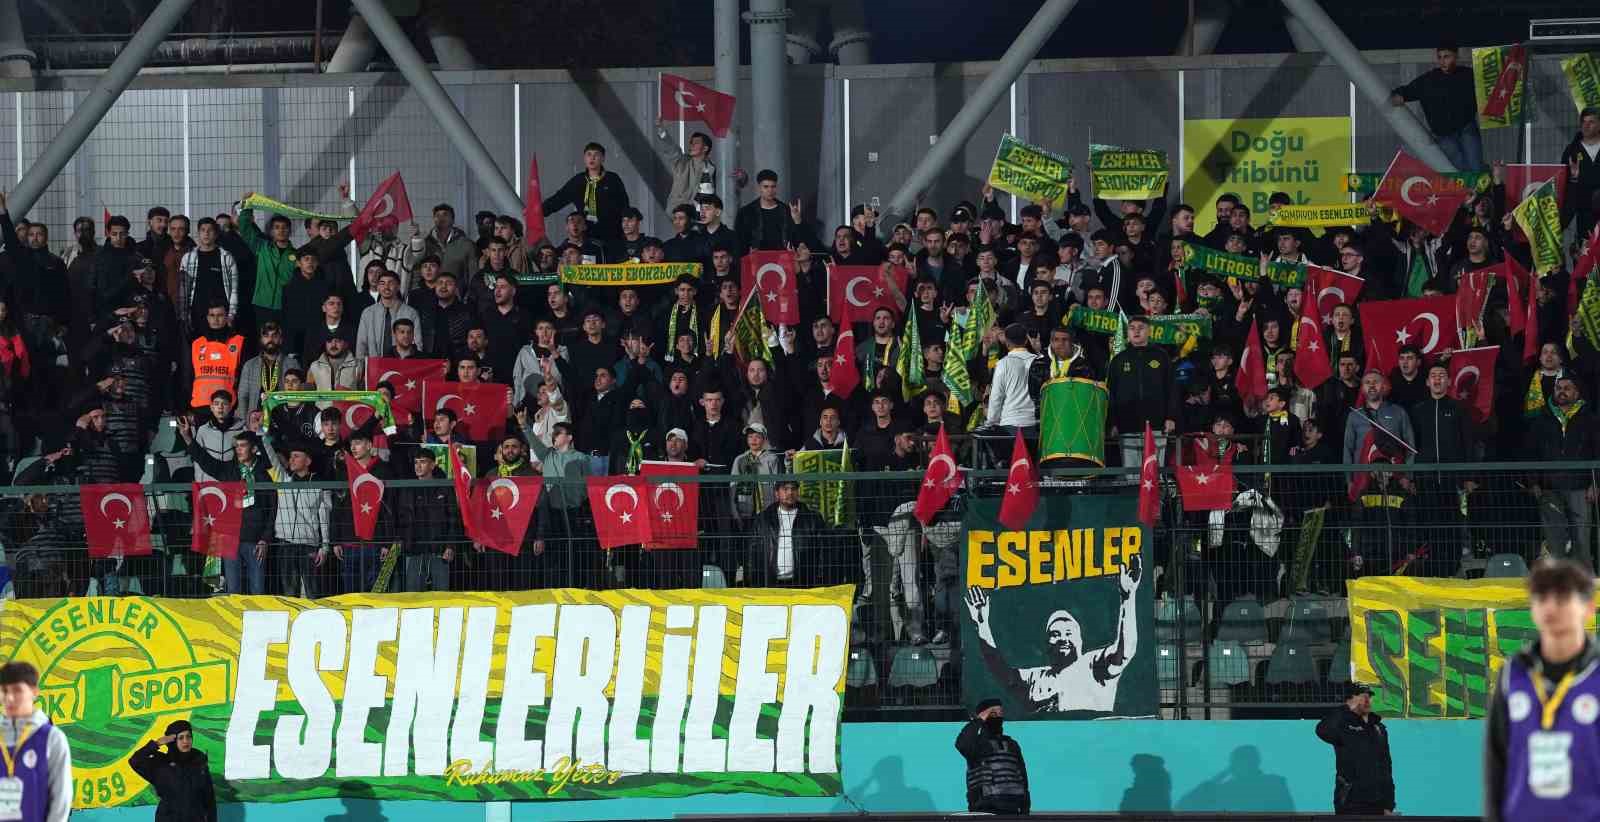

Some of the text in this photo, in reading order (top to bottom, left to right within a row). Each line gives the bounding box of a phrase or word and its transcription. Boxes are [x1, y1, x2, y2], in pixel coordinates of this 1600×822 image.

[1231, 130, 1304, 157] Doğu
[1006, 146, 1064, 180] ESENLER
[1100, 152, 1162, 169] ESENLER
[1215, 159, 1320, 183] Tribünü
[1096, 173, 1167, 192] EROKSPOR
[1320, 207, 1352, 220] ESENLER
[967, 527, 1143, 589] ESENLER
[33, 599, 159, 656] ESENLER
[129, 672, 203, 710] SPOR
[73, 771, 127, 805] 1959
